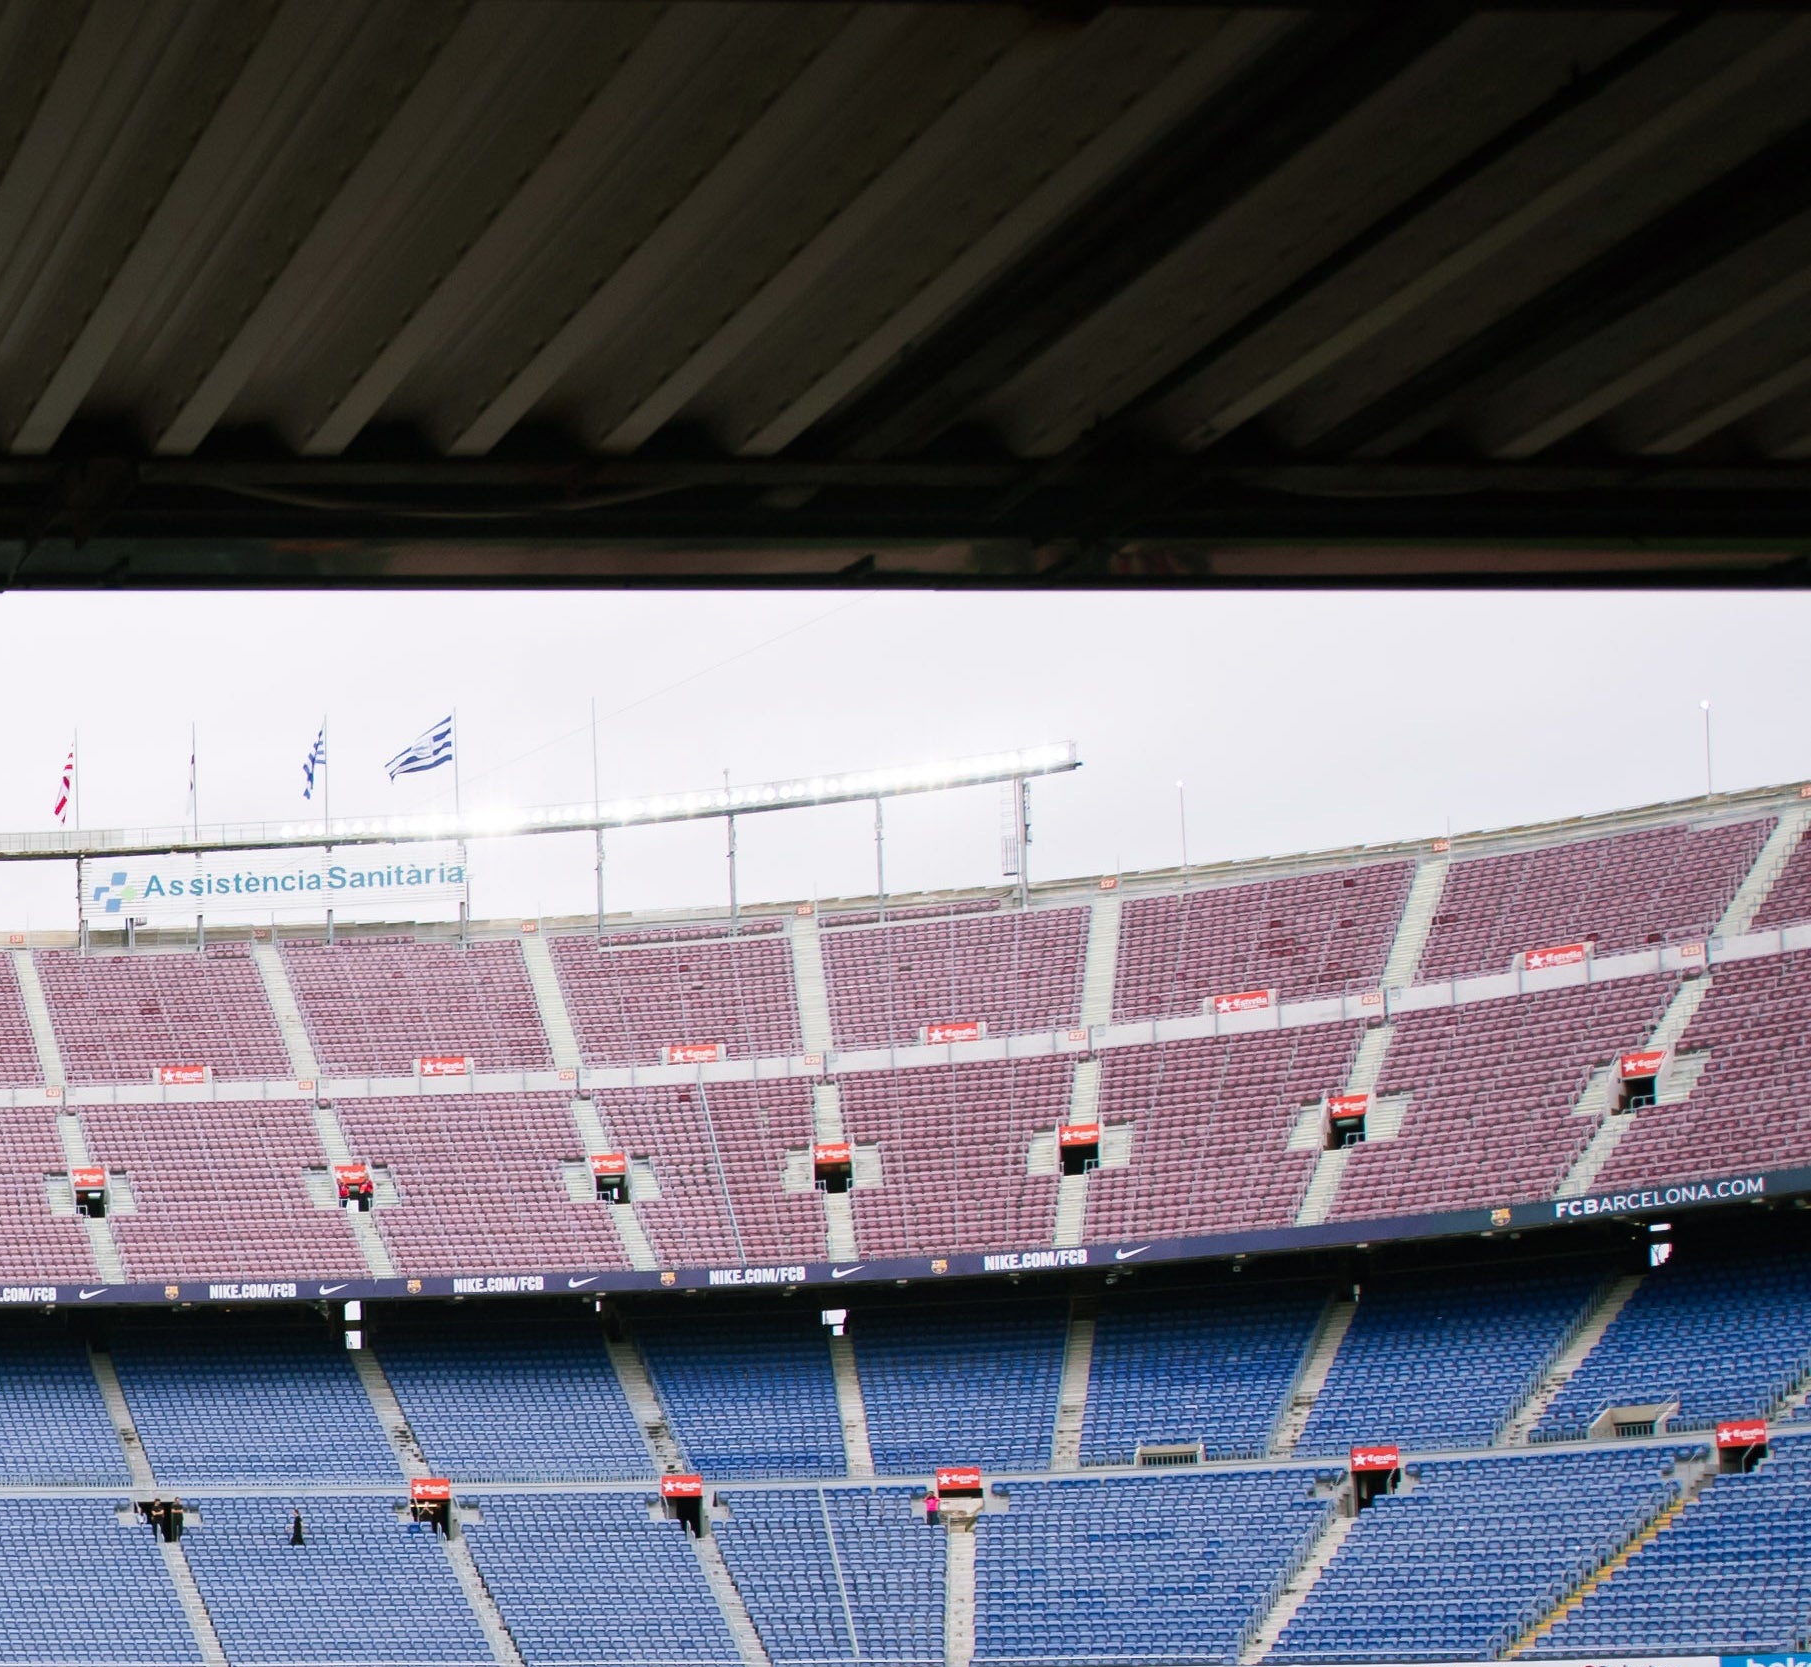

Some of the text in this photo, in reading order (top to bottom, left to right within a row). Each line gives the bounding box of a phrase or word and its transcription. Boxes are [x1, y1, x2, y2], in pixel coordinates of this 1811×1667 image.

[144, 861, 465, 899] Assistència Sanitària
[1556, 1176, 1764, 1217] FCBARCELONA.COM
[985, 1249, 1087, 1270] NIKE.COM/FCB
[454, 1276, 543, 1292] NIKE.COM/FCB
[710, 1266, 805, 1284] NIKE.COM/FCB
[210, 1283, 296, 1298] NIKE.COM/FCB
